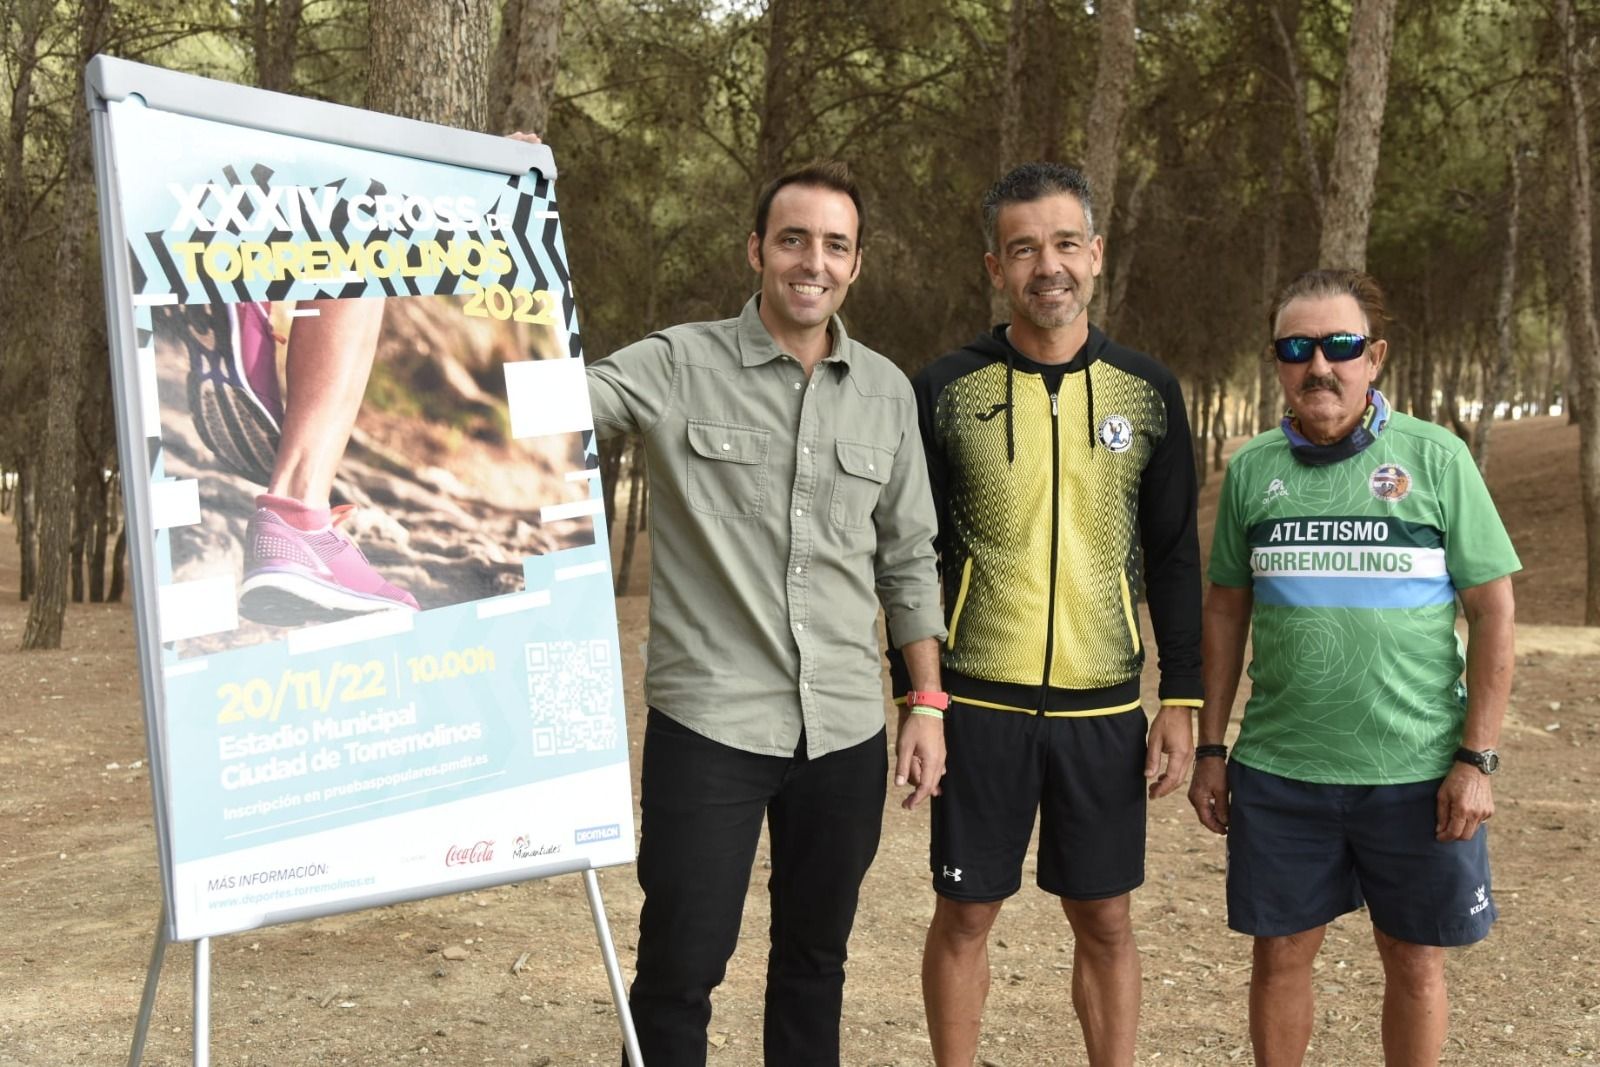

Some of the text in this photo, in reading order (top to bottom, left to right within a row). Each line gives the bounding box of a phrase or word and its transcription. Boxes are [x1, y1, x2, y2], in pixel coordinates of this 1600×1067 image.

[167, 183, 513, 231] XXXIV CROSS DE
[173, 240, 512, 283] TORREMOLINOS
[462, 280, 558, 325] 2022
[1269, 520, 1389, 543] ATLETISMO
[1253, 551, 1413, 573] TORREMOLINOS
[218, 647, 495, 723] 20/11/22 10.00h
[218, 704, 417, 760] Estadio Municipal
[222, 723, 482, 789] Ciudad de Torremolinos
[223, 789, 301, 820] Inscripción
[304, 786, 321, 802] en
[207, 864, 329, 892] MÁS INFORMACIÓN:
[208, 876, 376, 909] www.deportes.torremolinos.es
